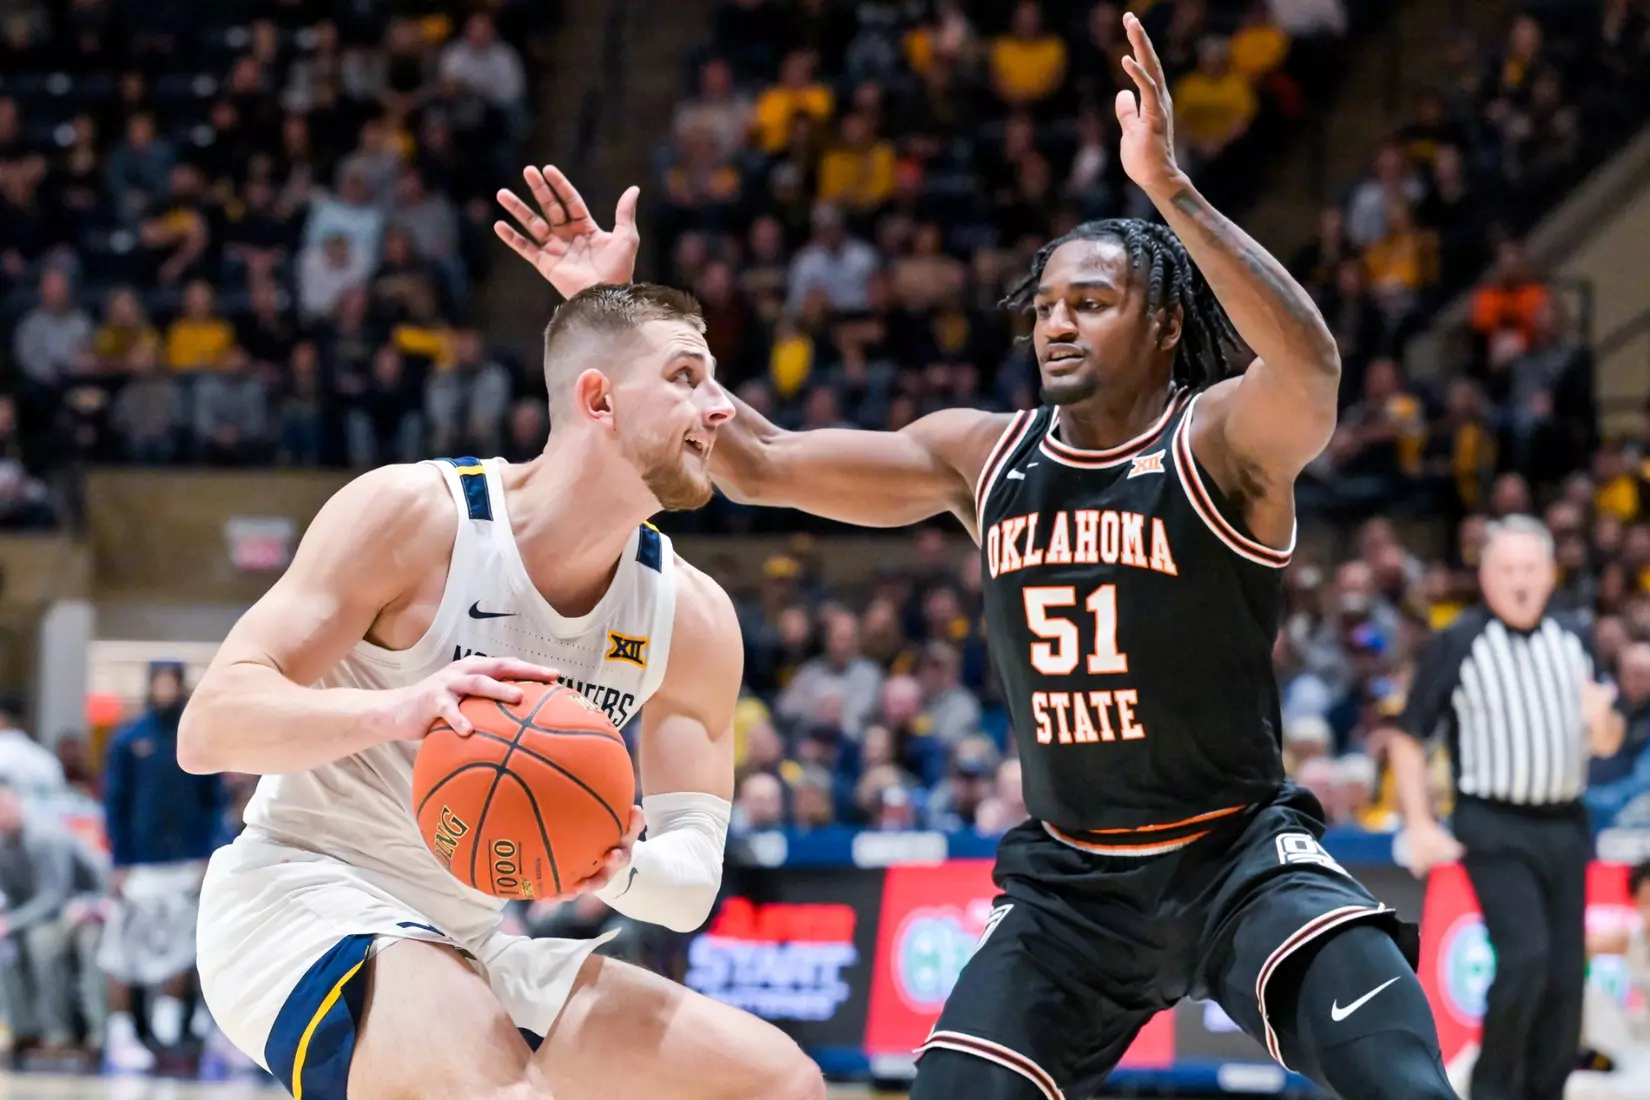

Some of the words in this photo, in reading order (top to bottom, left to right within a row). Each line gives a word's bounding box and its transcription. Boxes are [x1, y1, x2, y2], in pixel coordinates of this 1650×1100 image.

[1130, 452, 1164, 476] XII
[987, 509, 1178, 579] OKLAHOMA
[609, 634, 646, 665] XII
[1022, 583, 1128, 675] 51
[1031, 688, 1146, 744] STATE
[493, 839, 518, 894] 1000
